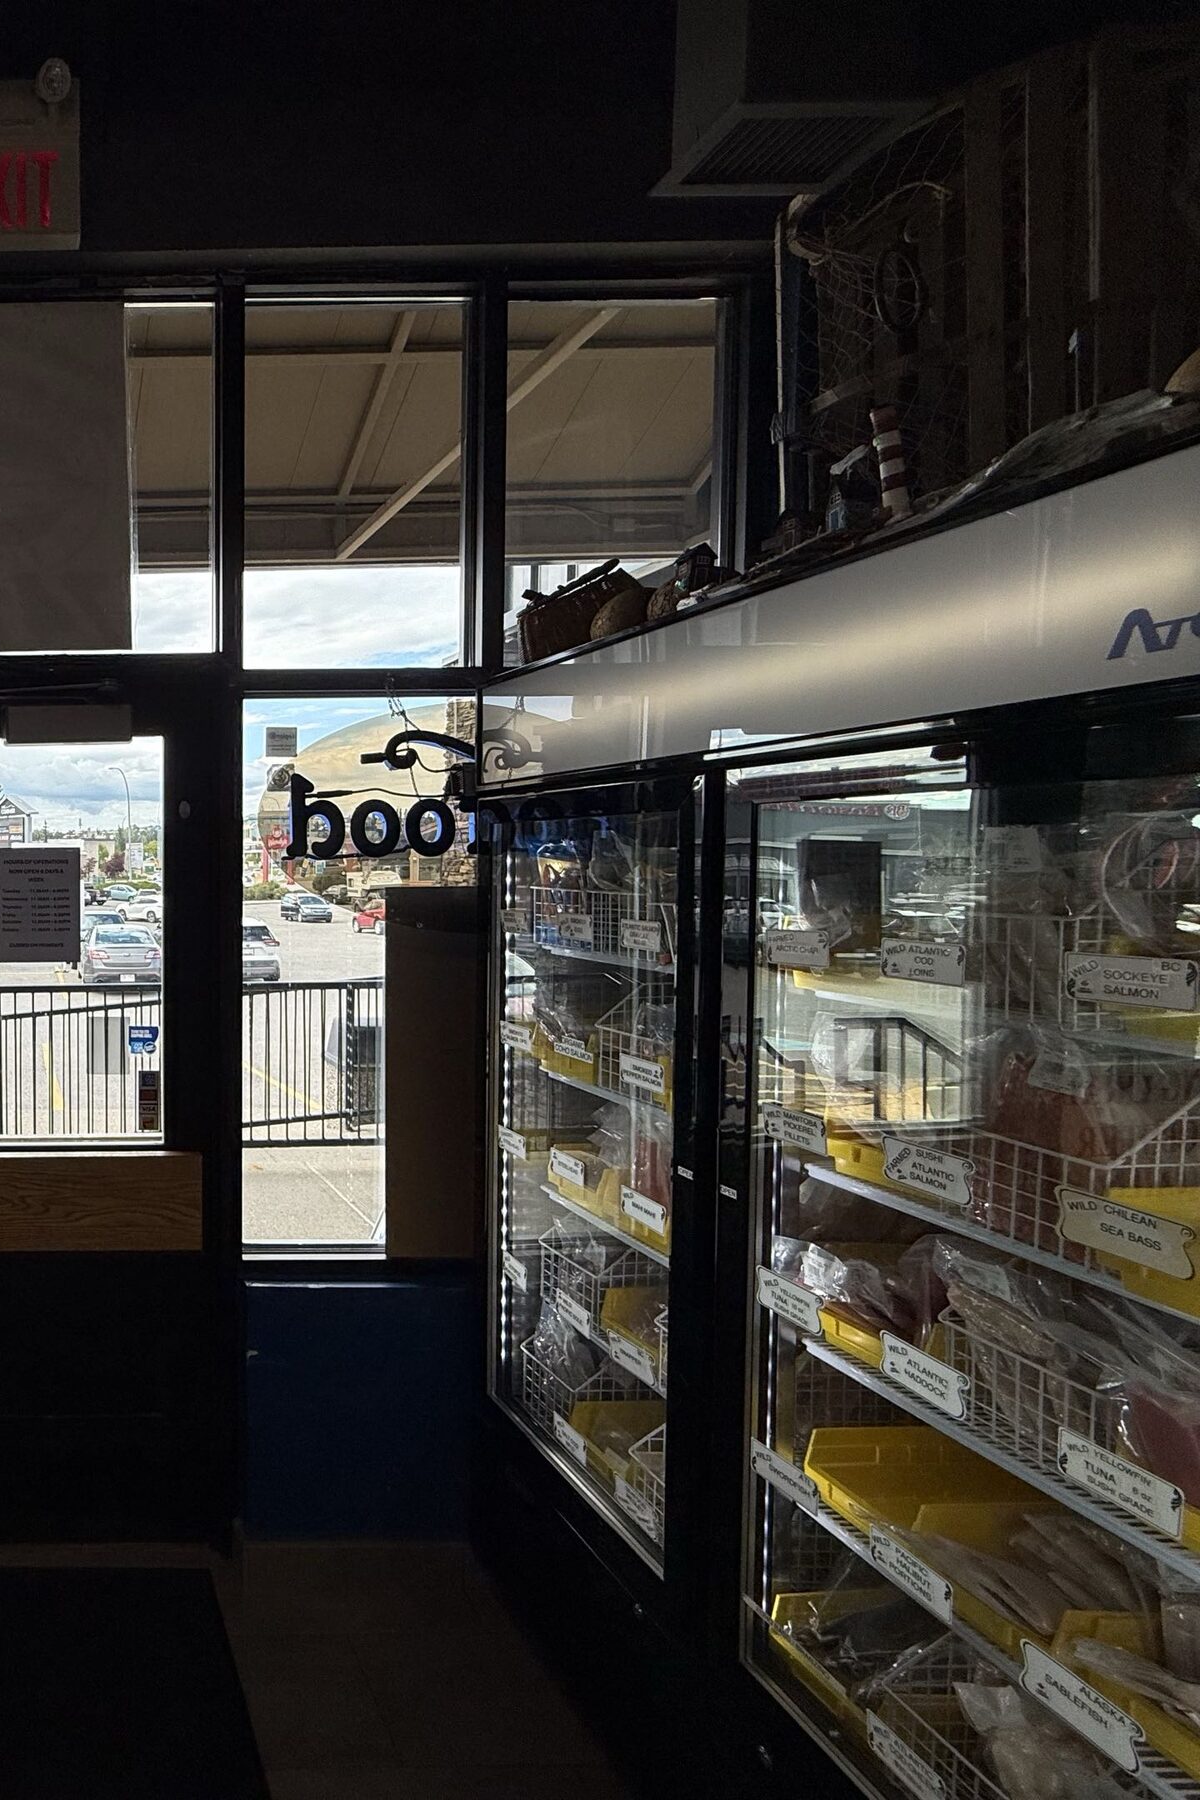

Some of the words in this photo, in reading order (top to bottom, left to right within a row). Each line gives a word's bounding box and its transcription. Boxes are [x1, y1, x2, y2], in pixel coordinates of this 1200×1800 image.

[768, 934, 795, 943] FARMED
[776, 944, 800, 953] ARCTIC
[800, 946, 819, 955] CHAR
[886, 944, 905, 956] WILD
[908, 944, 951, 957] ATLANTIC
[914, 956, 934, 966] COD
[1070, 960, 1099, 978] WILD
[1161, 961, 1181, 972] BC
[909, 968, 935, 978] LOINS
[1103, 969, 1169, 985] SOCKEYE
[1103, 984, 1159, 999] SALMON
[561, 1037, 585, 1049] ORGANIC
[555, 1044, 571, 1053] COHO
[570, 1048, 593, 1062] SALMON
[623, 1069, 643, 1082] PEPPER
[642, 1074, 662, 1088] SALMON
[632, 1064, 653, 1077] SMOKED
[765, 1109, 782, 1120] WILD
[783, 1111, 818, 1129] MANITOBA
[783, 1120, 817, 1137] PICKEREL
[784, 1131, 811, 1146] FILLETS
[886, 1147, 911, 1173] FARMED
[915, 1149, 944, 1164] SUSHI
[909, 1171, 947, 1191] SALMON
[911, 1161, 955, 1183] ATLANTIC
[719, 1186, 737, 1199] OPEN
[1067, 1200, 1098, 1211] WILD
[1103, 1204, 1157, 1230] CHILEAN
[1100, 1222, 1124, 1238] SEA
[1127, 1231, 1162, 1251] BASS
[763, 1278, 779, 1288] WILD
[771, 1290, 788, 1305] TUNA
[779, 1286, 810, 1309] YELLOWFIN
[888, 1343, 908, 1356] WILD
[906, 1358, 949, 1389] ATLANTIC
[904, 1368, 946, 1400] HADDOCK
[755, 1451, 772, 1462] WILD
[1066, 1442, 1089, 1454] WILD
[1094, 1449, 1152, 1487] YELLOWFIN
[769, 1463, 811, 1497] SWORDFISH
[1083, 1459, 1117, 1486] TUNA
[1087, 1474, 1116, 1496] SUSHI
[1119, 1492, 1155, 1518] GRADE
[872, 1535, 890, 1548] WILD
[895, 1546, 929, 1576] PACIFIC
[896, 1555, 932, 1589] HALIBUT
[889, 1562, 933, 1602] PORTIONS
[1044, 1672, 1109, 1730] SABLEFISH
[1079, 1685, 1126, 1727] ALASKA
